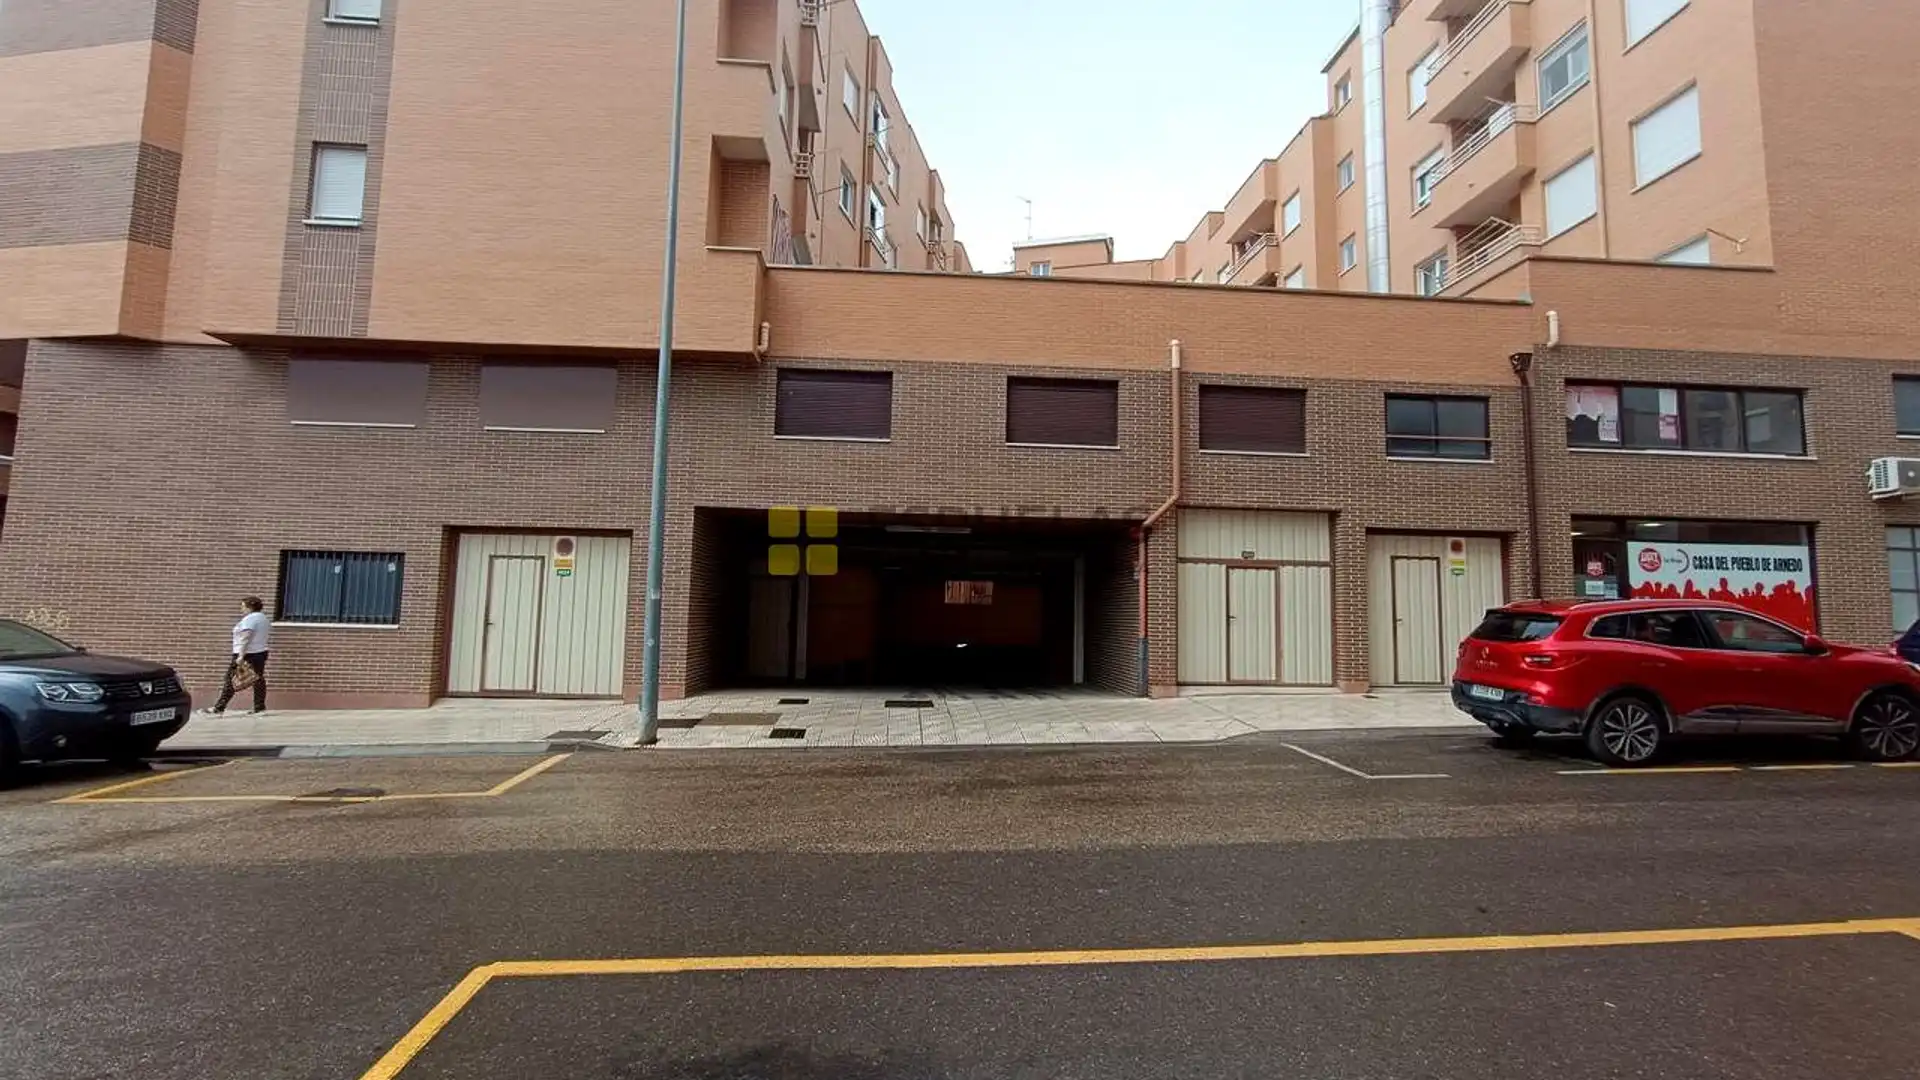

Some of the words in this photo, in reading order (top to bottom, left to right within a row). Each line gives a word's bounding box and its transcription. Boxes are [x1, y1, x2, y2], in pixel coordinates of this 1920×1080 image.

[1692, 555, 1714, 571] CASA
[1715, 556, 1729, 571] DEL
[1731, 556, 1760, 572] PUEBLO
[1761, 557, 1772, 572] DE
[1773, 558, 1803, 572] ARNEDO
